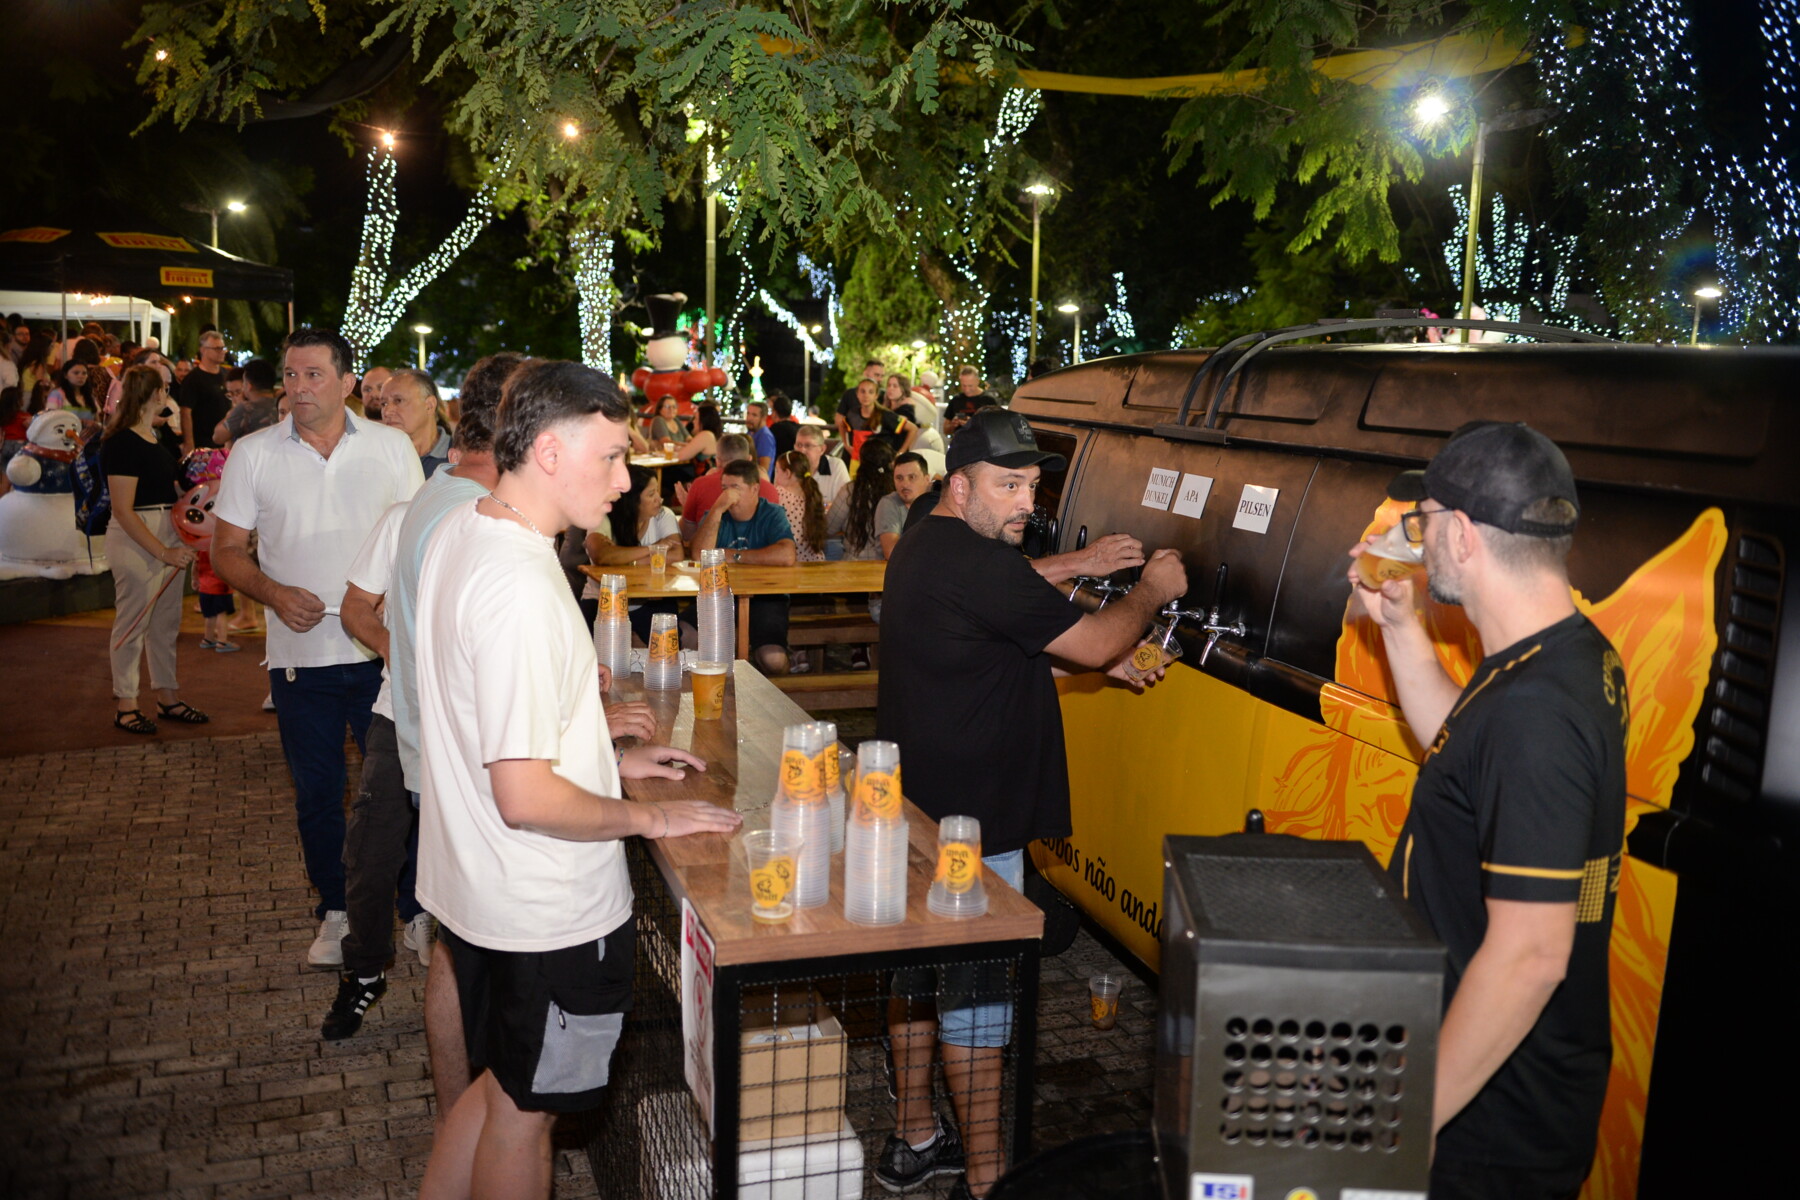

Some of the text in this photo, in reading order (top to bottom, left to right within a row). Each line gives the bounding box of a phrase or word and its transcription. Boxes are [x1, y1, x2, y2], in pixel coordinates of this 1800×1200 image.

[109, 235, 187, 250] PIRELLI
[165, 271, 208, 285] PIRELLI
[1150, 473, 1176, 489] MUNICH
[1144, 489, 1169, 505] DUNKEL
[1183, 491, 1199, 503] APA
[1239, 500, 1272, 518] PILSEN
[1084, 856, 1116, 902] não
